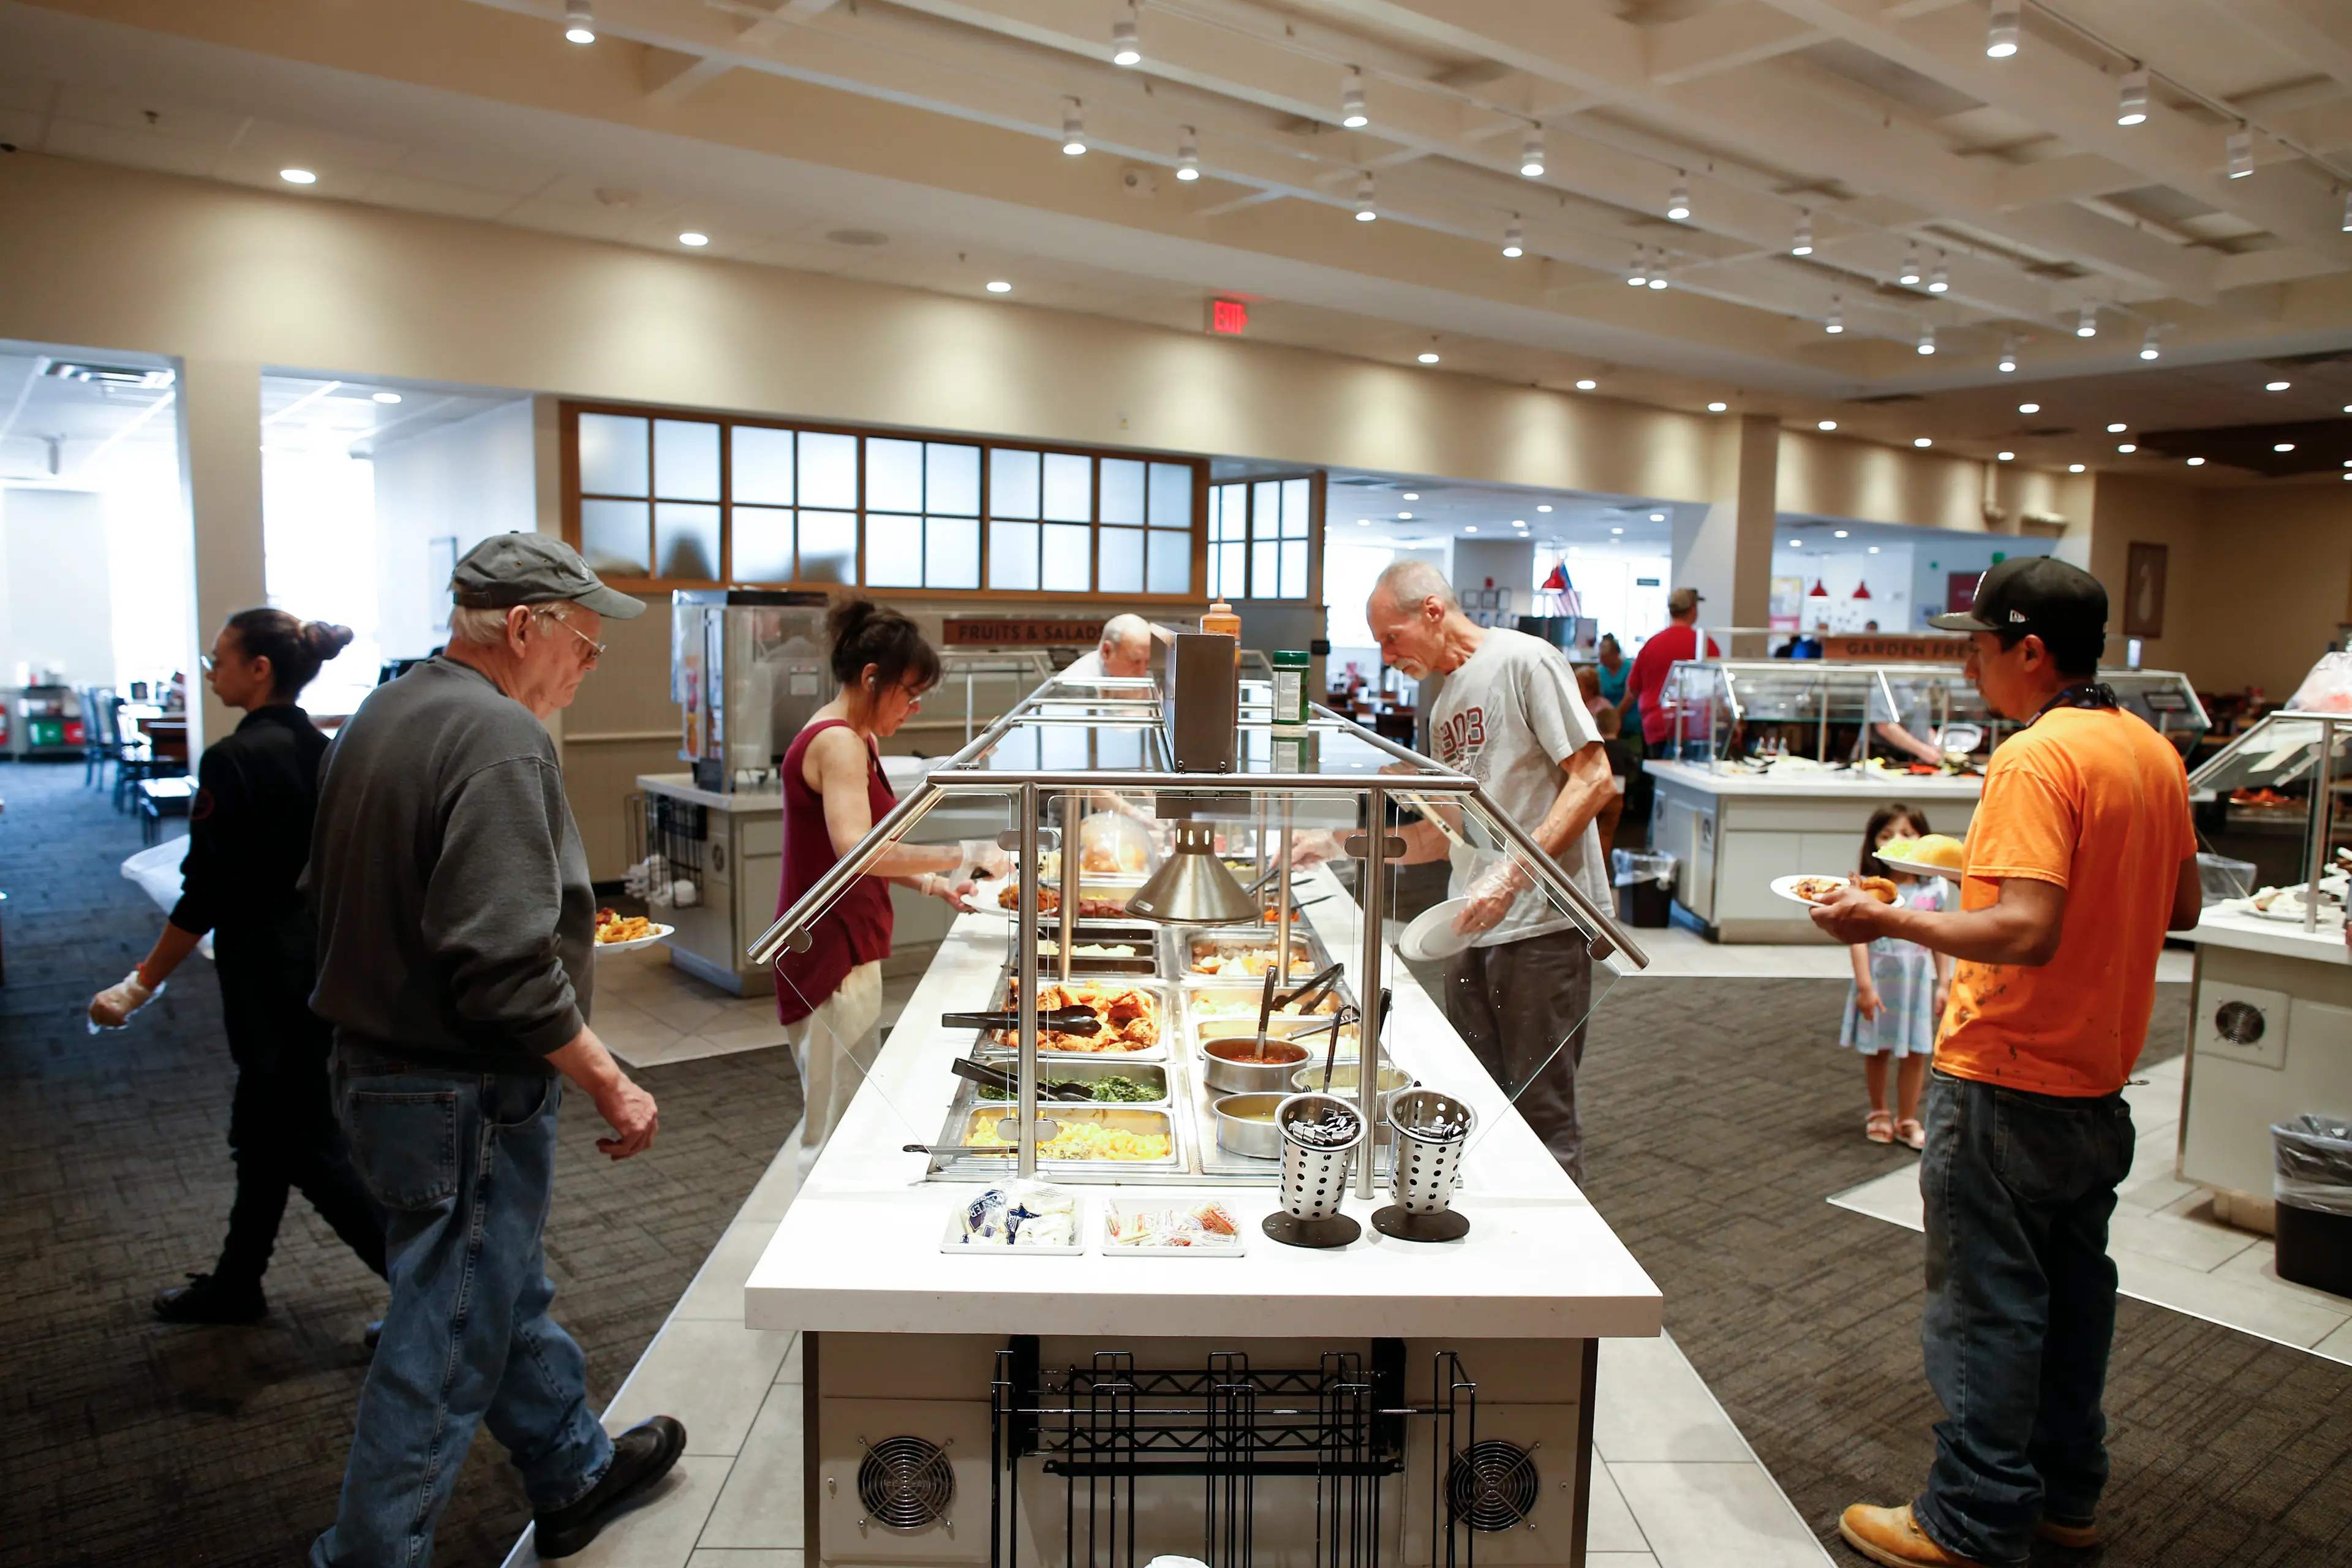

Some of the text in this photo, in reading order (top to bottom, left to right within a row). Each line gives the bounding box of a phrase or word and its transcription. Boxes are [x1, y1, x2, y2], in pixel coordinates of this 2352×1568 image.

[959, 625, 1020, 639] FRUITS
[1026, 625, 1038, 639] &
[1847, 641, 1925, 656] GARDEN
